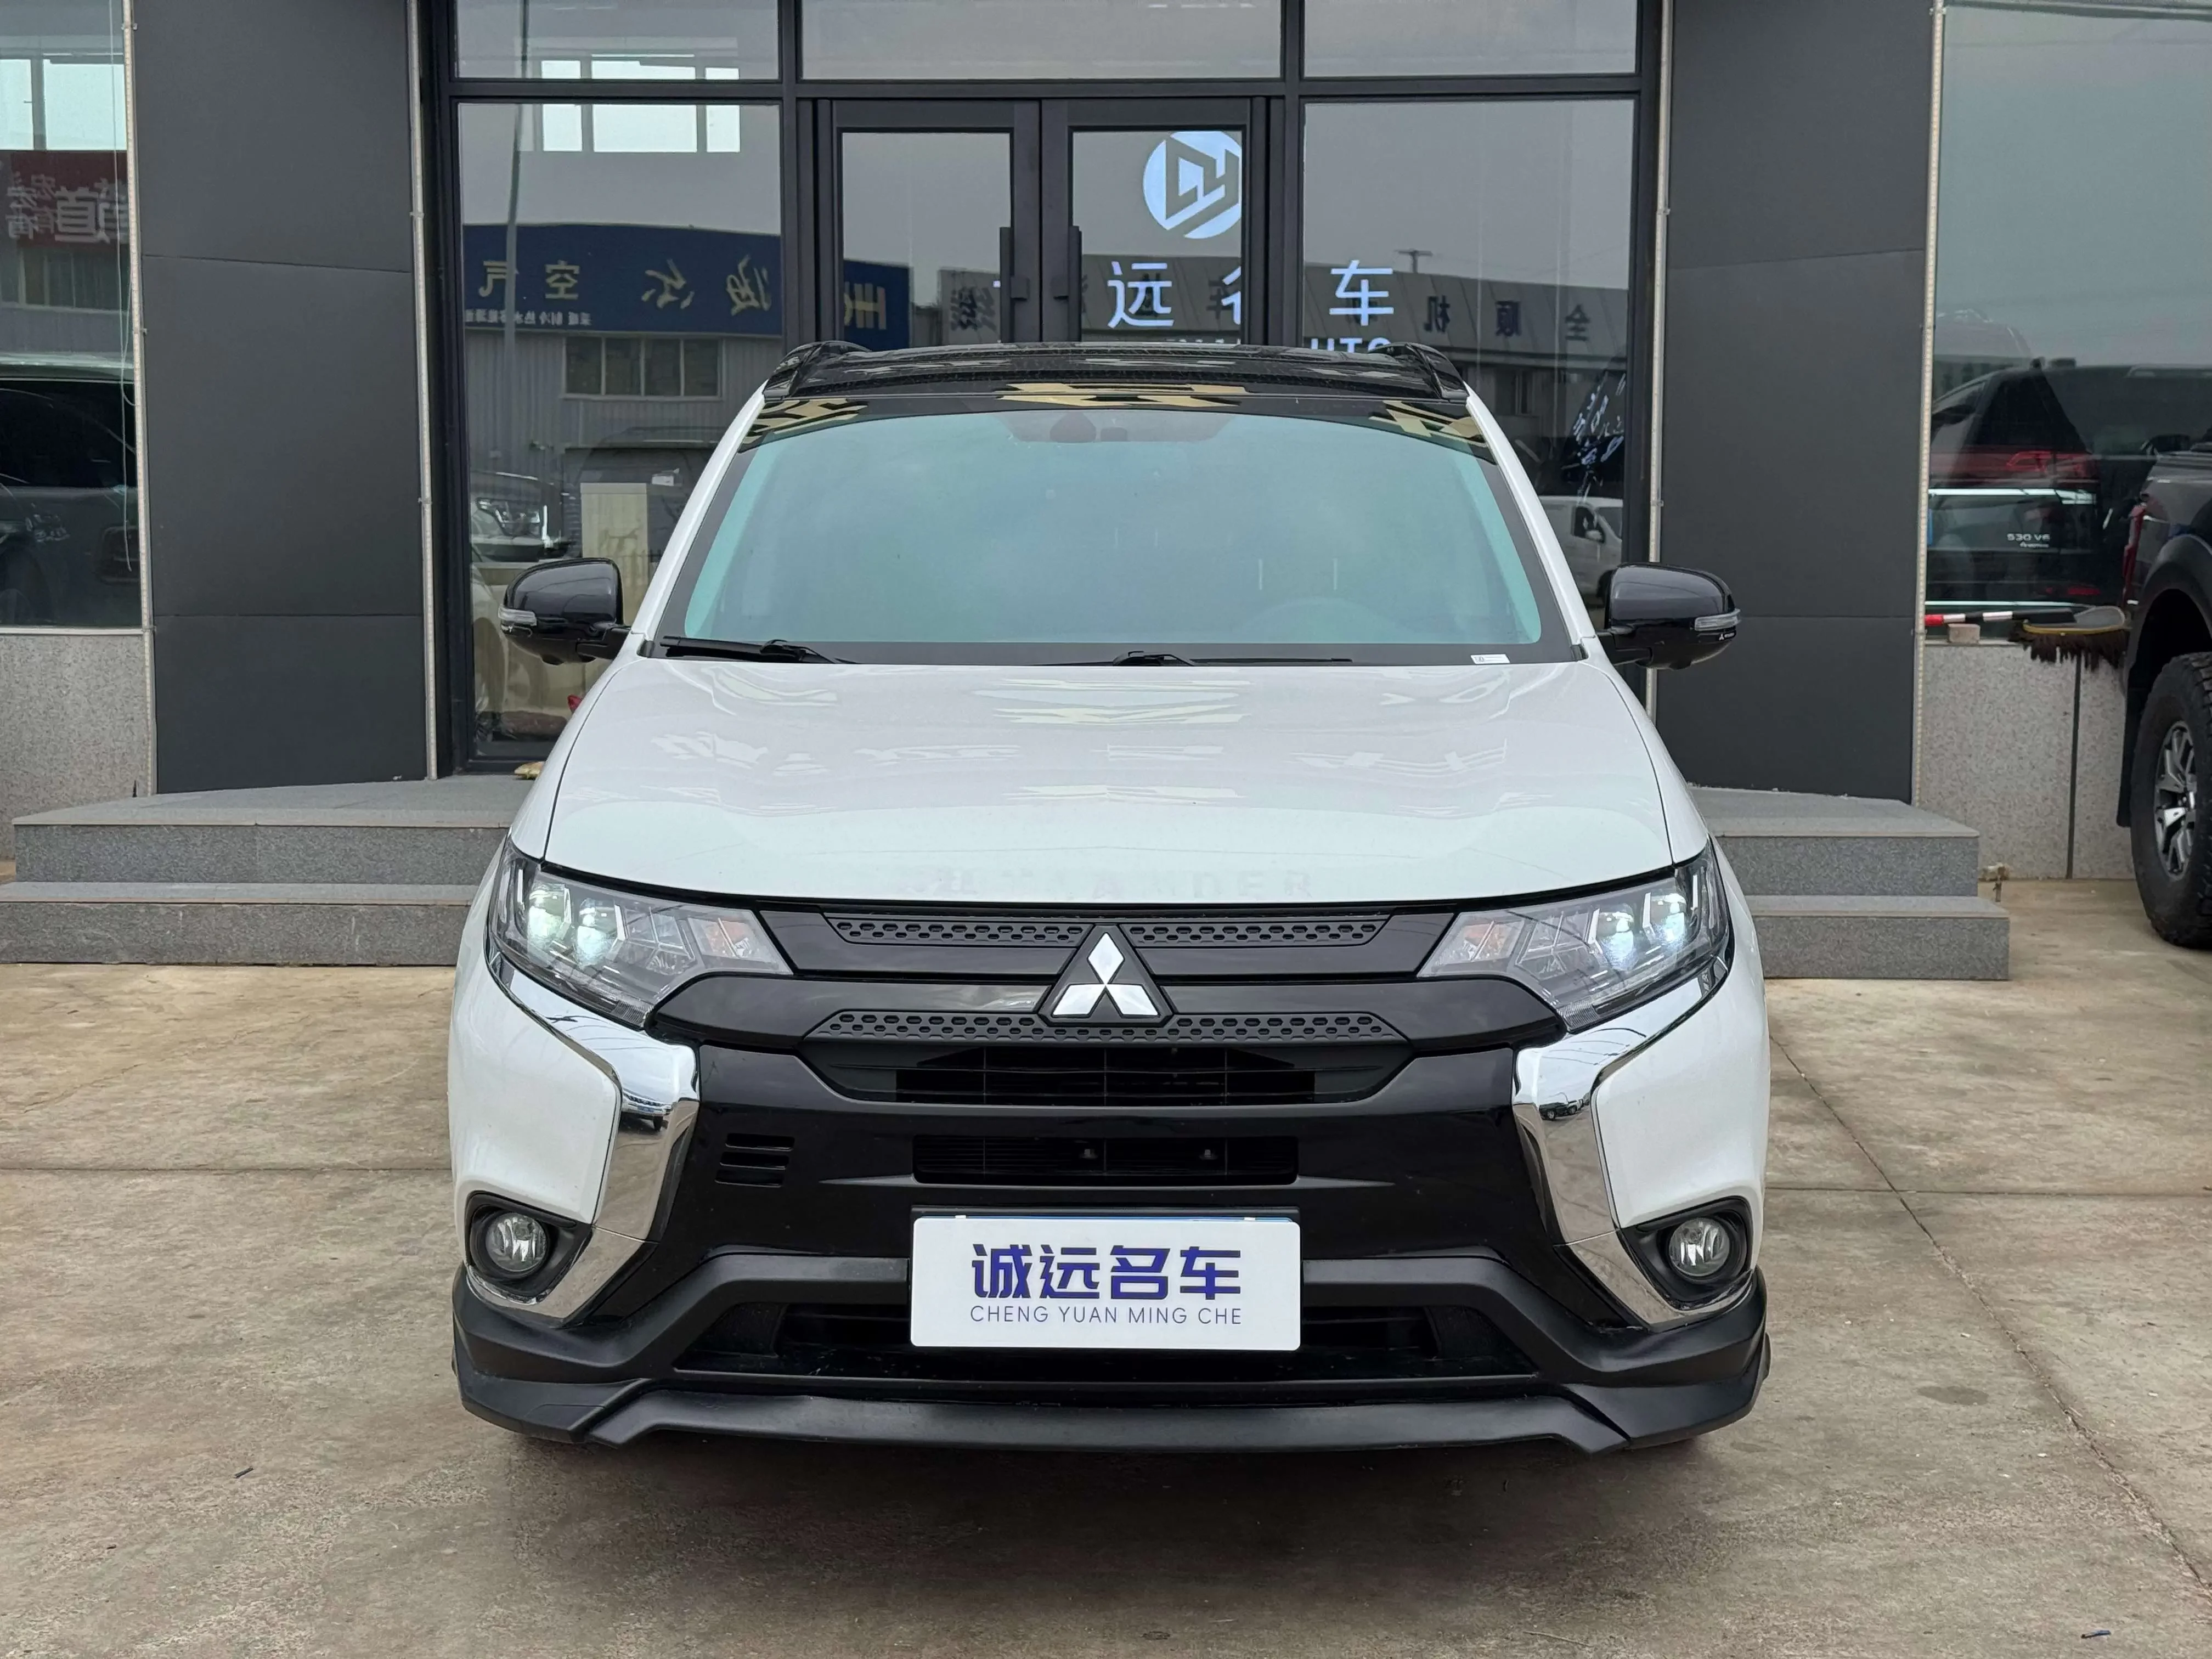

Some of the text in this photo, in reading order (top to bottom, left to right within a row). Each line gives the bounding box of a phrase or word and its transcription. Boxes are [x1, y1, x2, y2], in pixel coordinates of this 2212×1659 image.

[972, 1244, 1241, 1300] 诚远名车
[970, 1305, 1241, 1324] CHENG YUAN MING CHE
